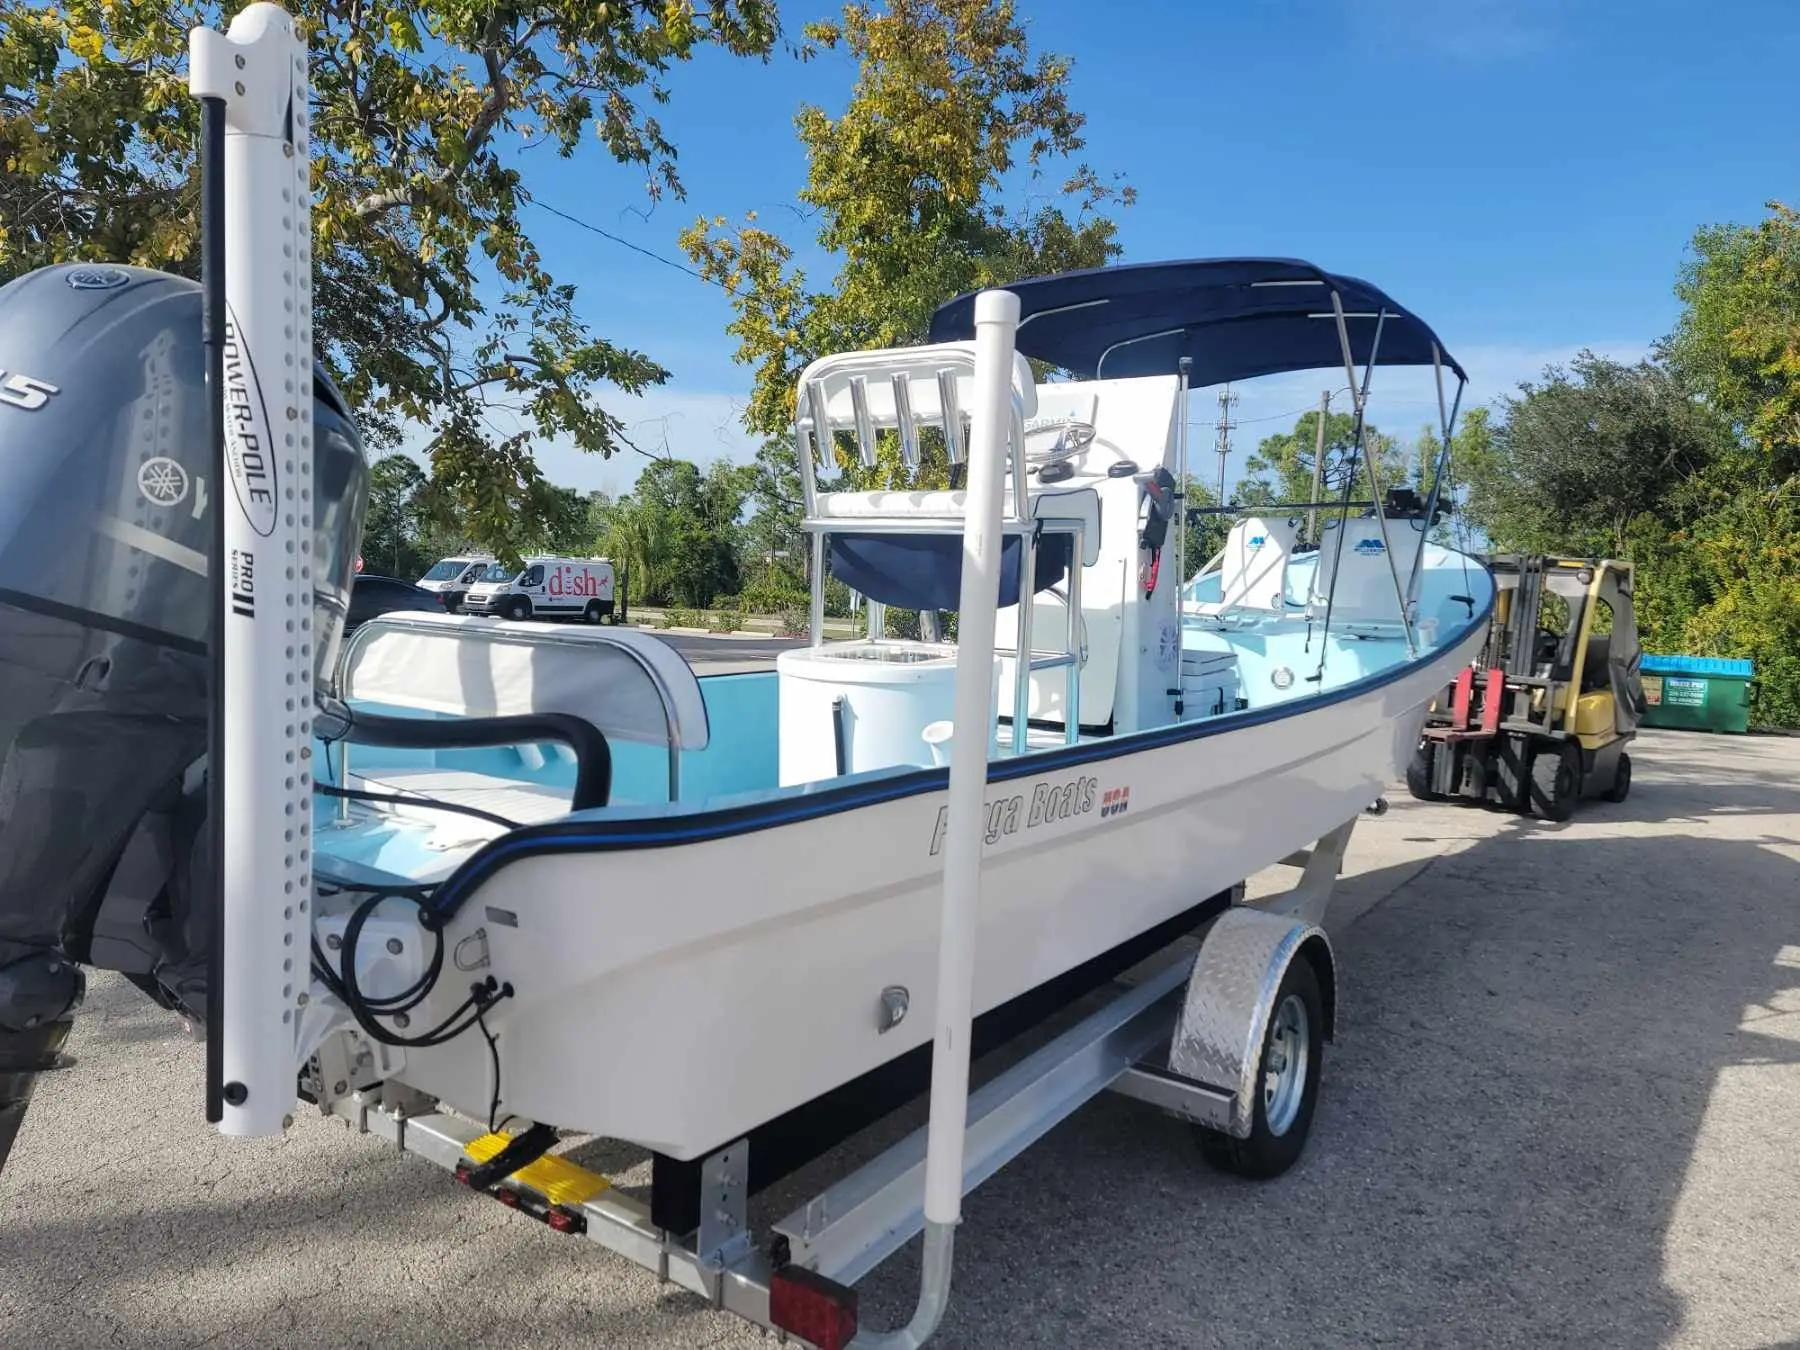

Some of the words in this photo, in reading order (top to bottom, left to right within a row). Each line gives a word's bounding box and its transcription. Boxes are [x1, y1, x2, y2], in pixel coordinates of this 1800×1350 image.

[0, 369, 61, 412] 5
[224, 322, 273, 505] POWER-POLE
[240, 551, 254, 593] PRO
[549, 565, 599, 596] dish
[929, 794, 1024, 856] Pga
[1026, 776, 1098, 828] Boats
